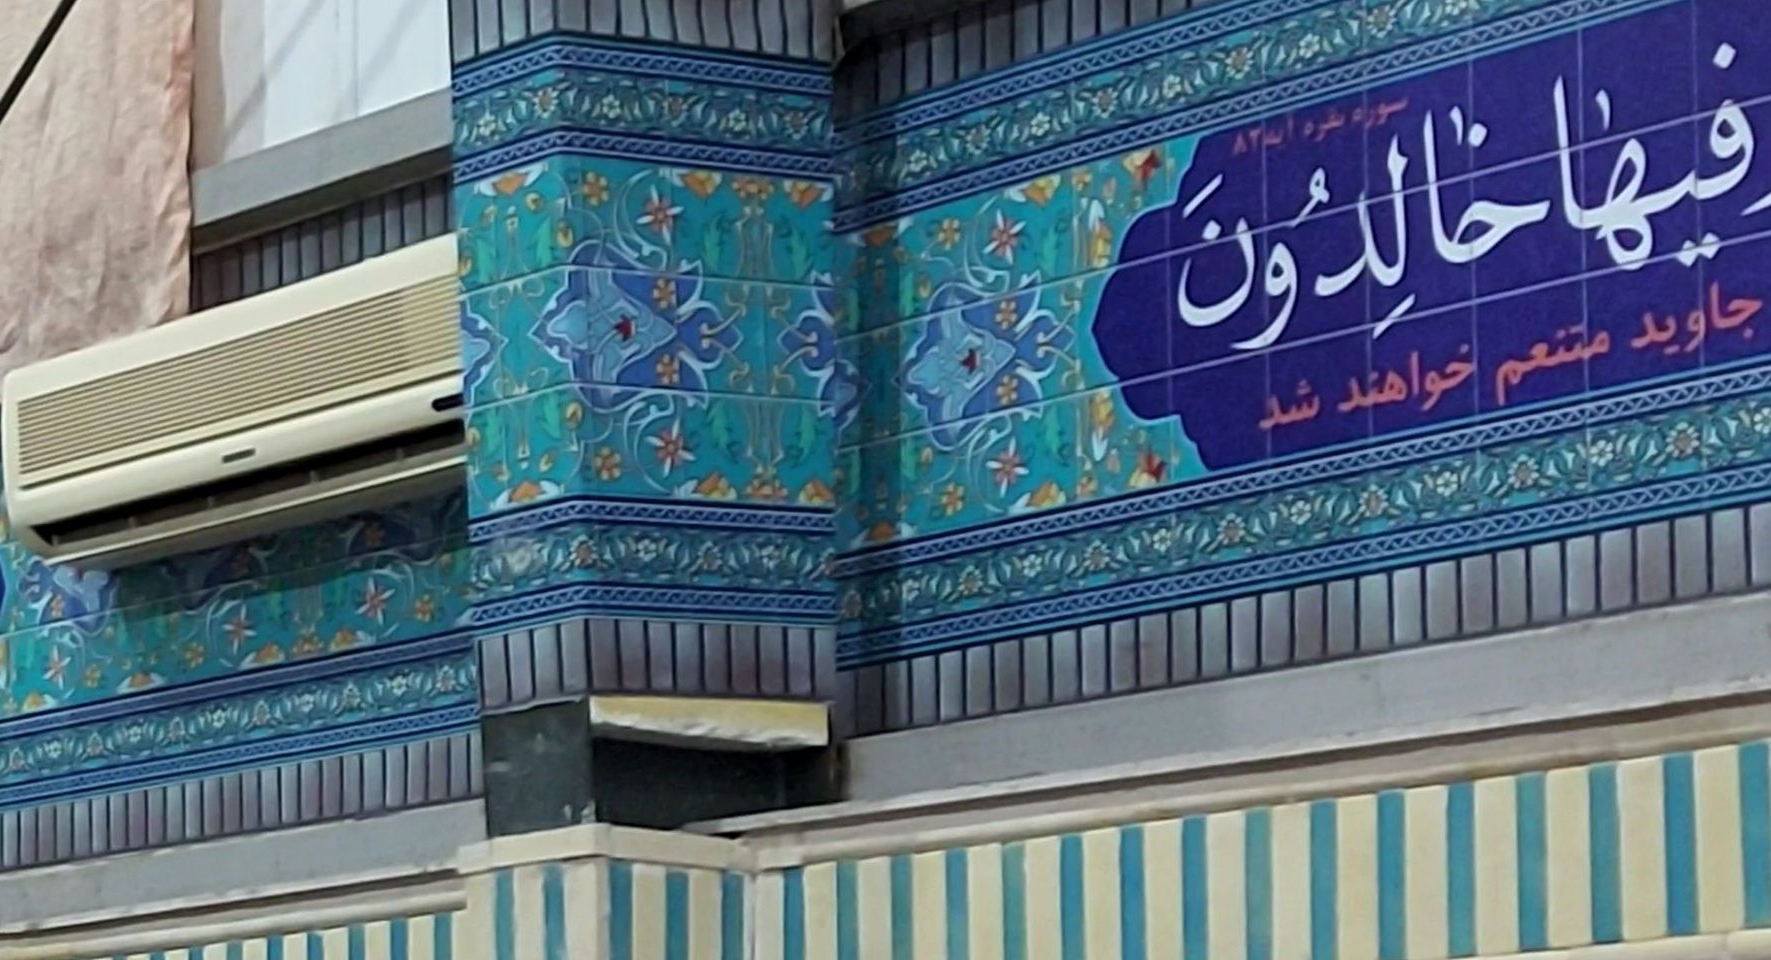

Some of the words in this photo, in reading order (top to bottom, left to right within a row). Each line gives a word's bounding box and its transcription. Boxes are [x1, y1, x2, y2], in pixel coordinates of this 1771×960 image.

[1631, 281, 1763, 354] جاوید
[1337, 343, 1475, 412] خواهند
[1495, 323, 1611, 406] متنعم
[1258, 378, 1321, 430] شد
